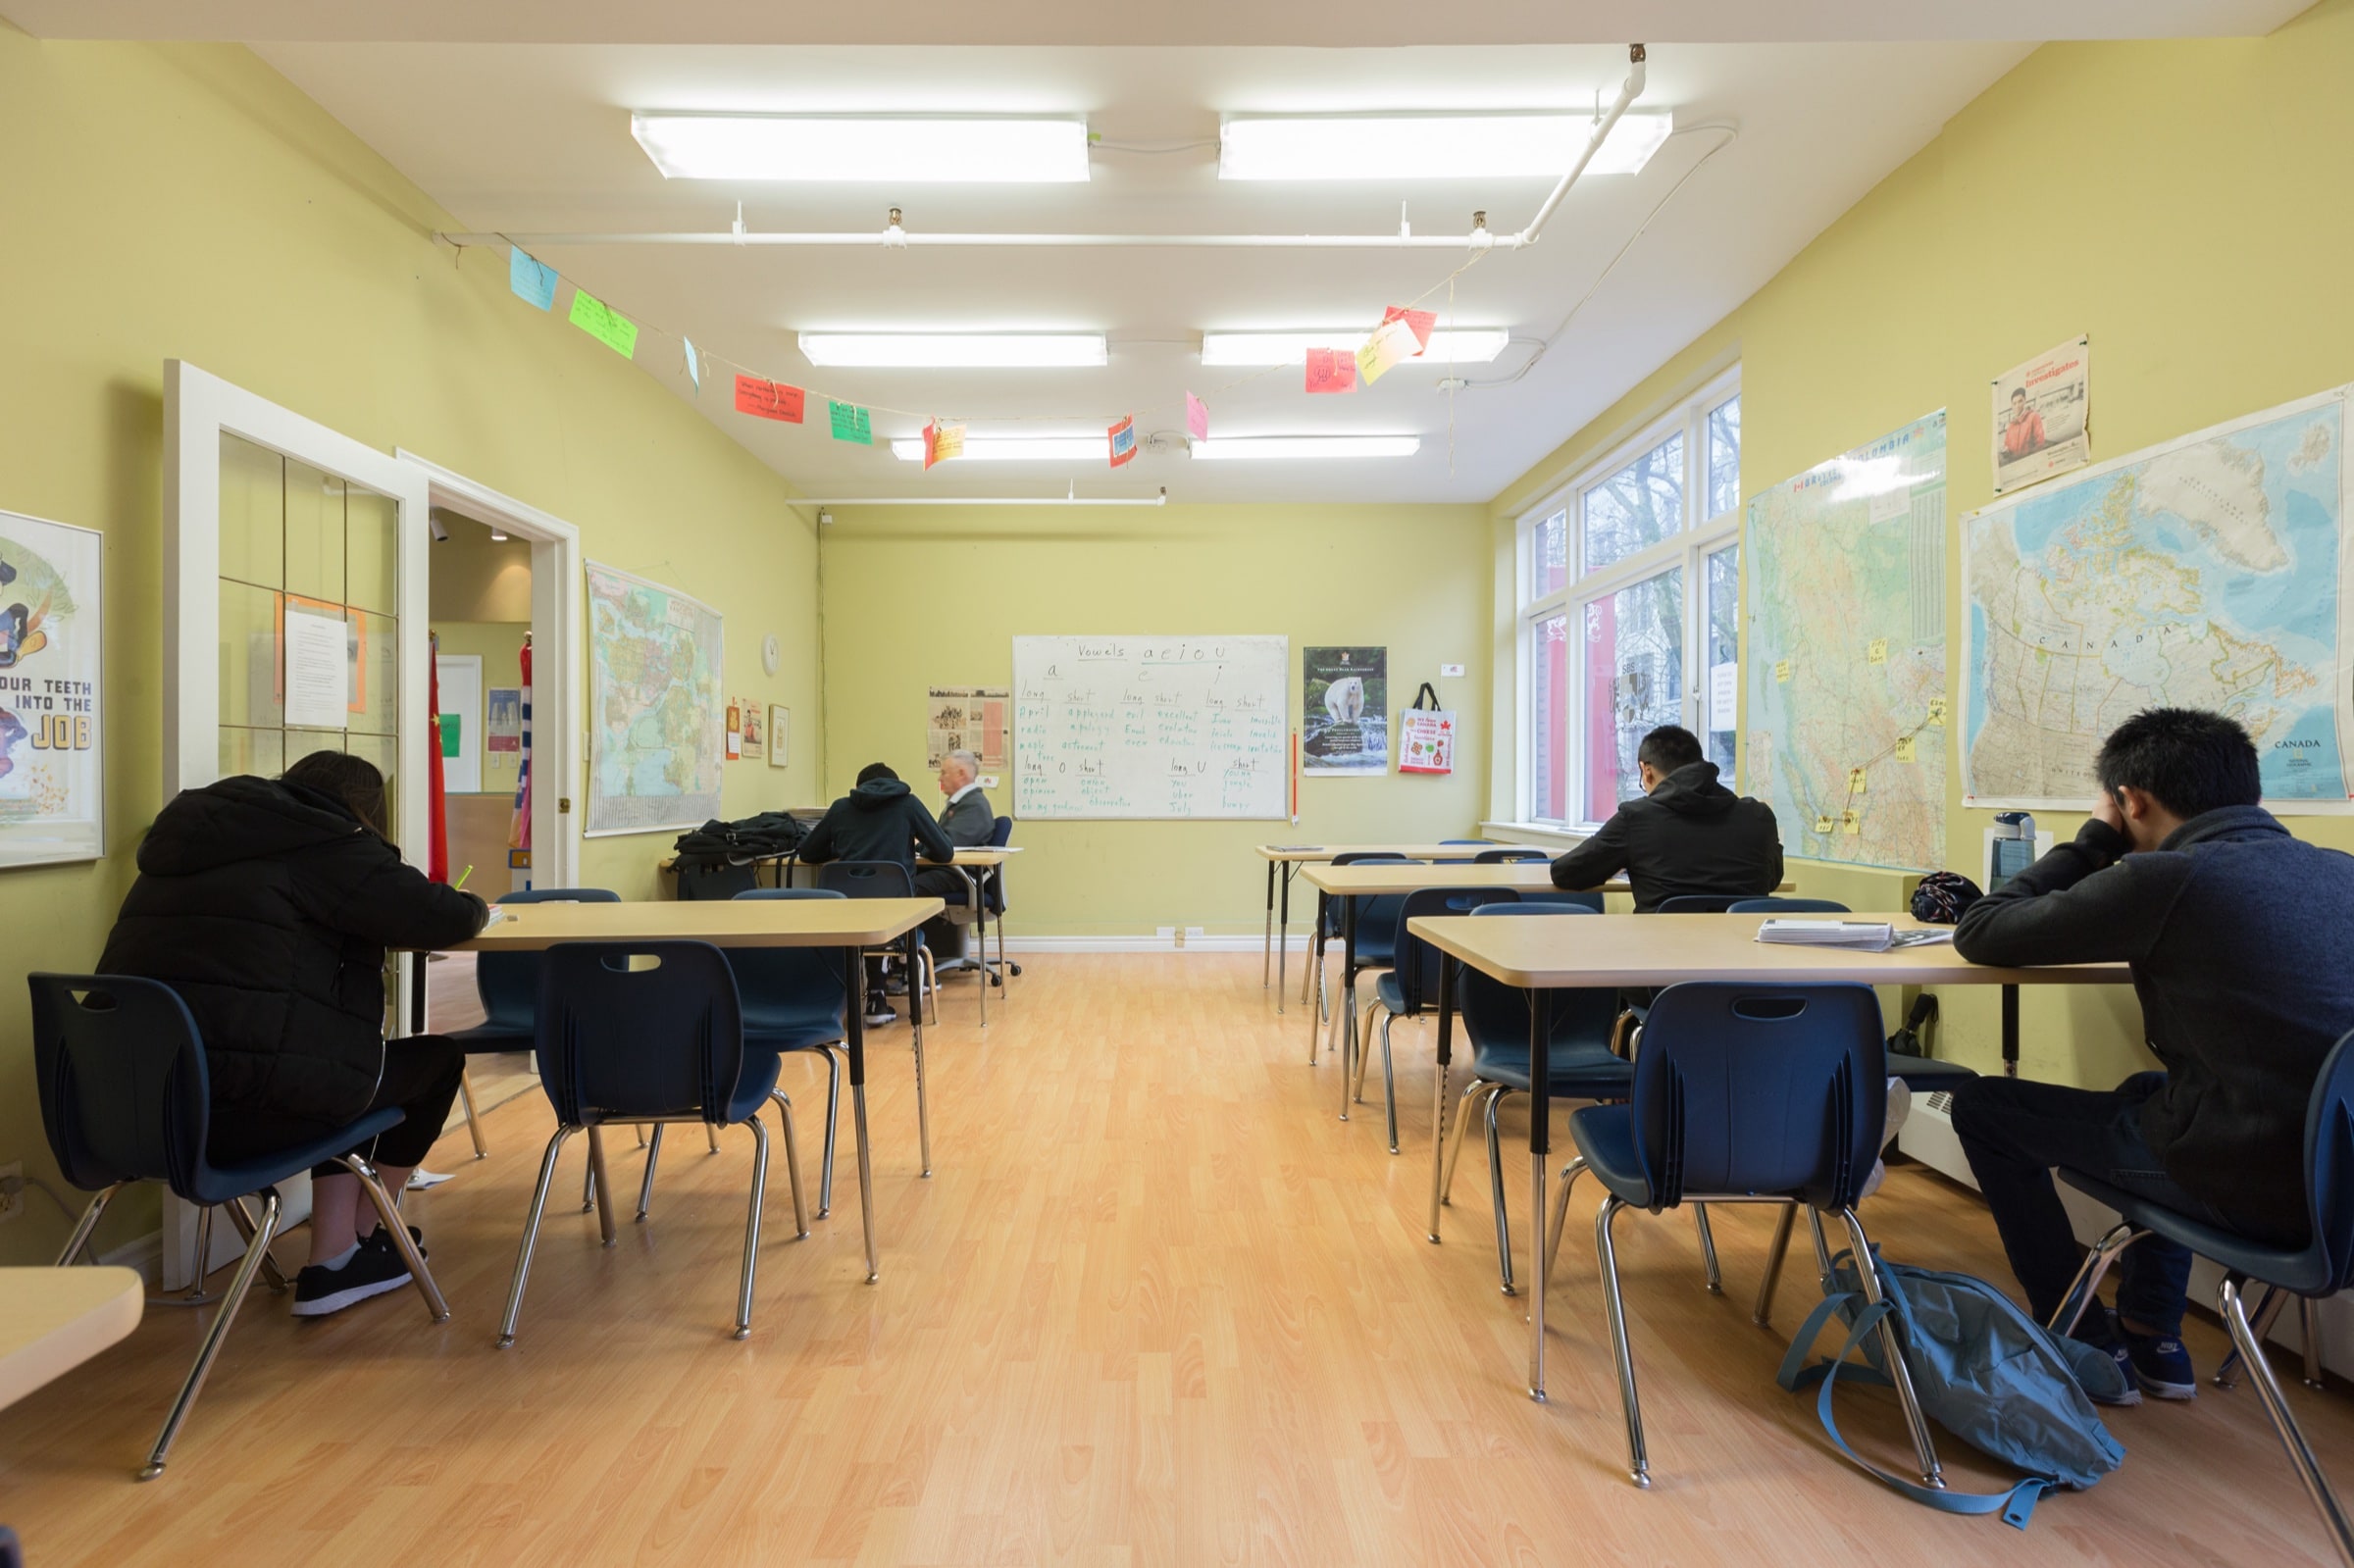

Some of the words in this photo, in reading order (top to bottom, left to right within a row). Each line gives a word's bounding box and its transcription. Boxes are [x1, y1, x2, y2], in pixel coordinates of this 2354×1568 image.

[1078, 643, 1125, 657] Vowels
[1048, 664, 1058, 677] a
[0, 677, 31, 690] OUR
[44, 680, 91, 695] TEETH
[1021, 679, 1045, 703] long
[1067, 688, 1096, 702] short
[1123, 688, 1144, 705] long
[1154, 690, 1182, 705] short
[1205, 688, 1224, 713] long
[1236, 691, 1266, 708] short
[16, 695, 53, 710] INTO
[64, 697, 91, 712] THE
[1019, 705, 1049, 720] April
[31, 714, 92, 751] JOB
[1021, 724, 1047, 736] radio
[2275, 739, 2321, 749] CANADA
[1024, 754, 1043, 777] long
[1078, 757, 1104, 776] short
[1170, 756, 1189, 774] long
[1232, 757, 1260, 771] short
[2160, 1341, 2177, 1350] NIKE
